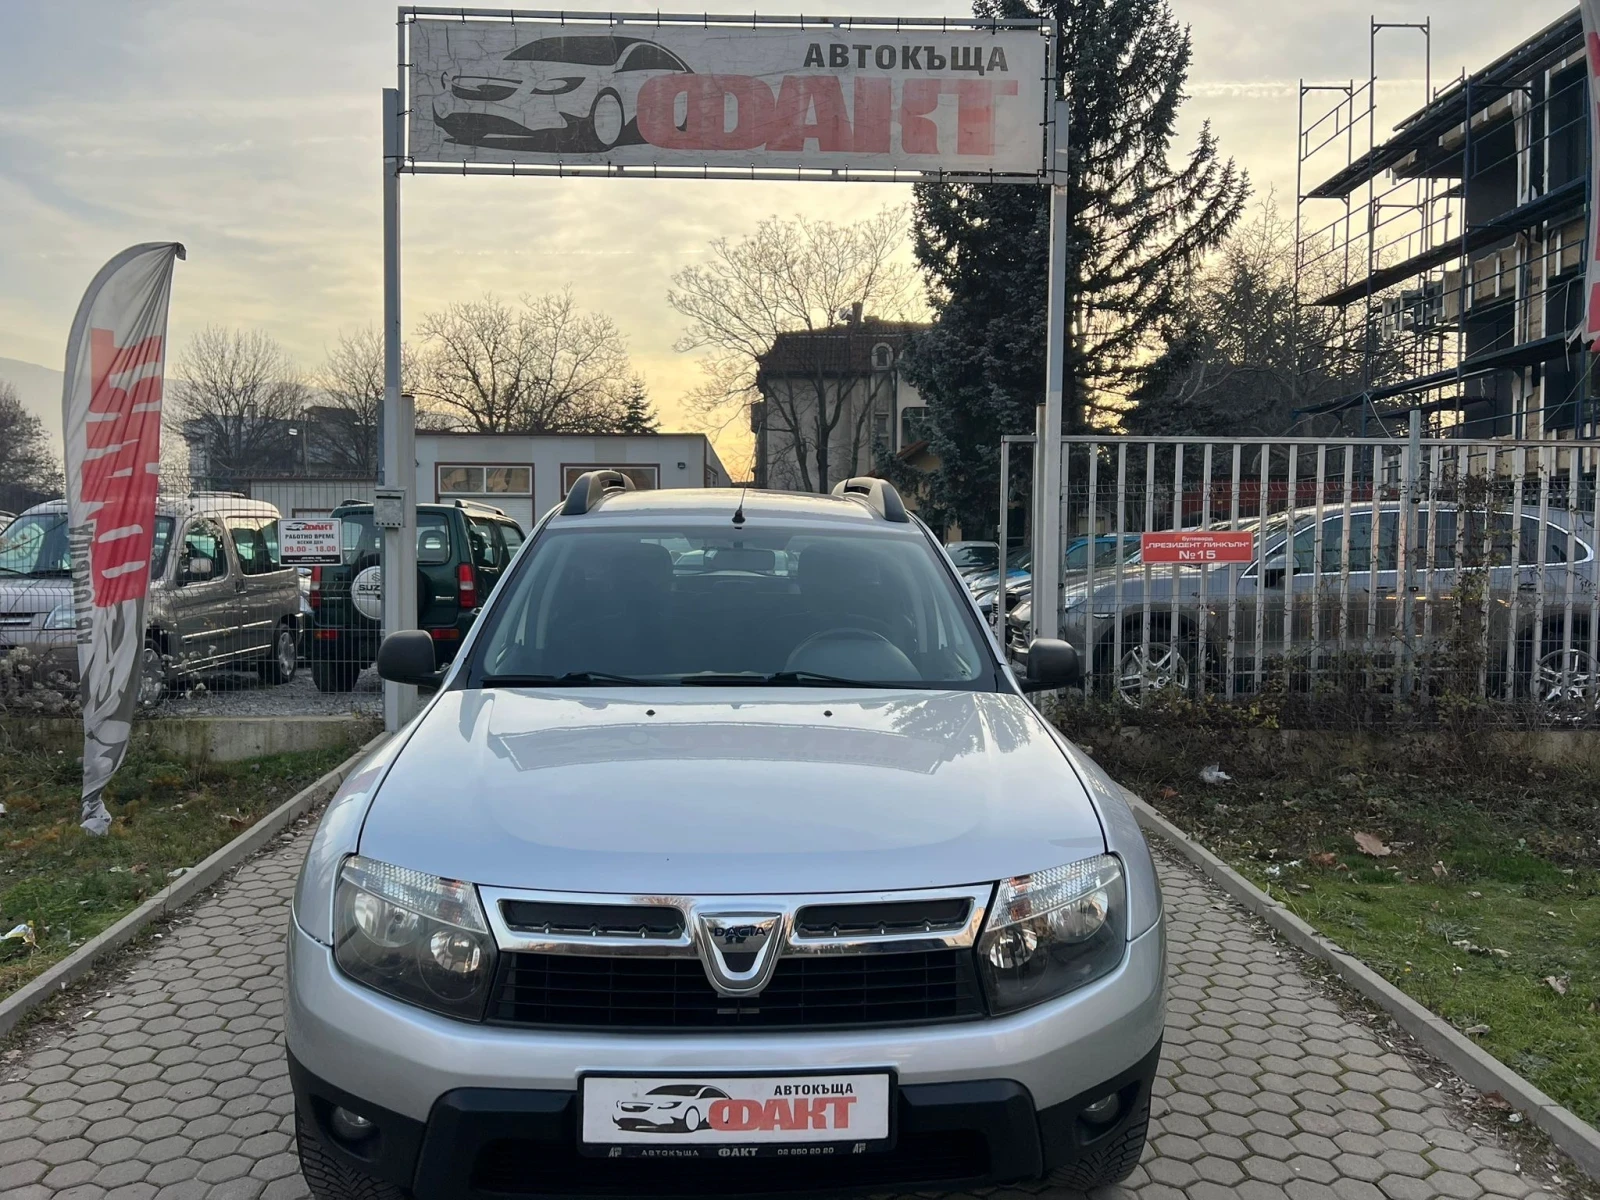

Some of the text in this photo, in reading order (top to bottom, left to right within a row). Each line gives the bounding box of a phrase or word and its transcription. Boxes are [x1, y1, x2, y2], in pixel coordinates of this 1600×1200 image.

[803, 43, 1009, 76] АВТОКЪЩА
[636, 73, 1018, 155] ФАКТ
[714, 926, 766, 937] DACIA
[774, 1083, 854, 1096] АВТОКЪЩА
[708, 1096, 857, 1131] ФАКТ
[718, 1147, 758, 1157] ФАКТ
